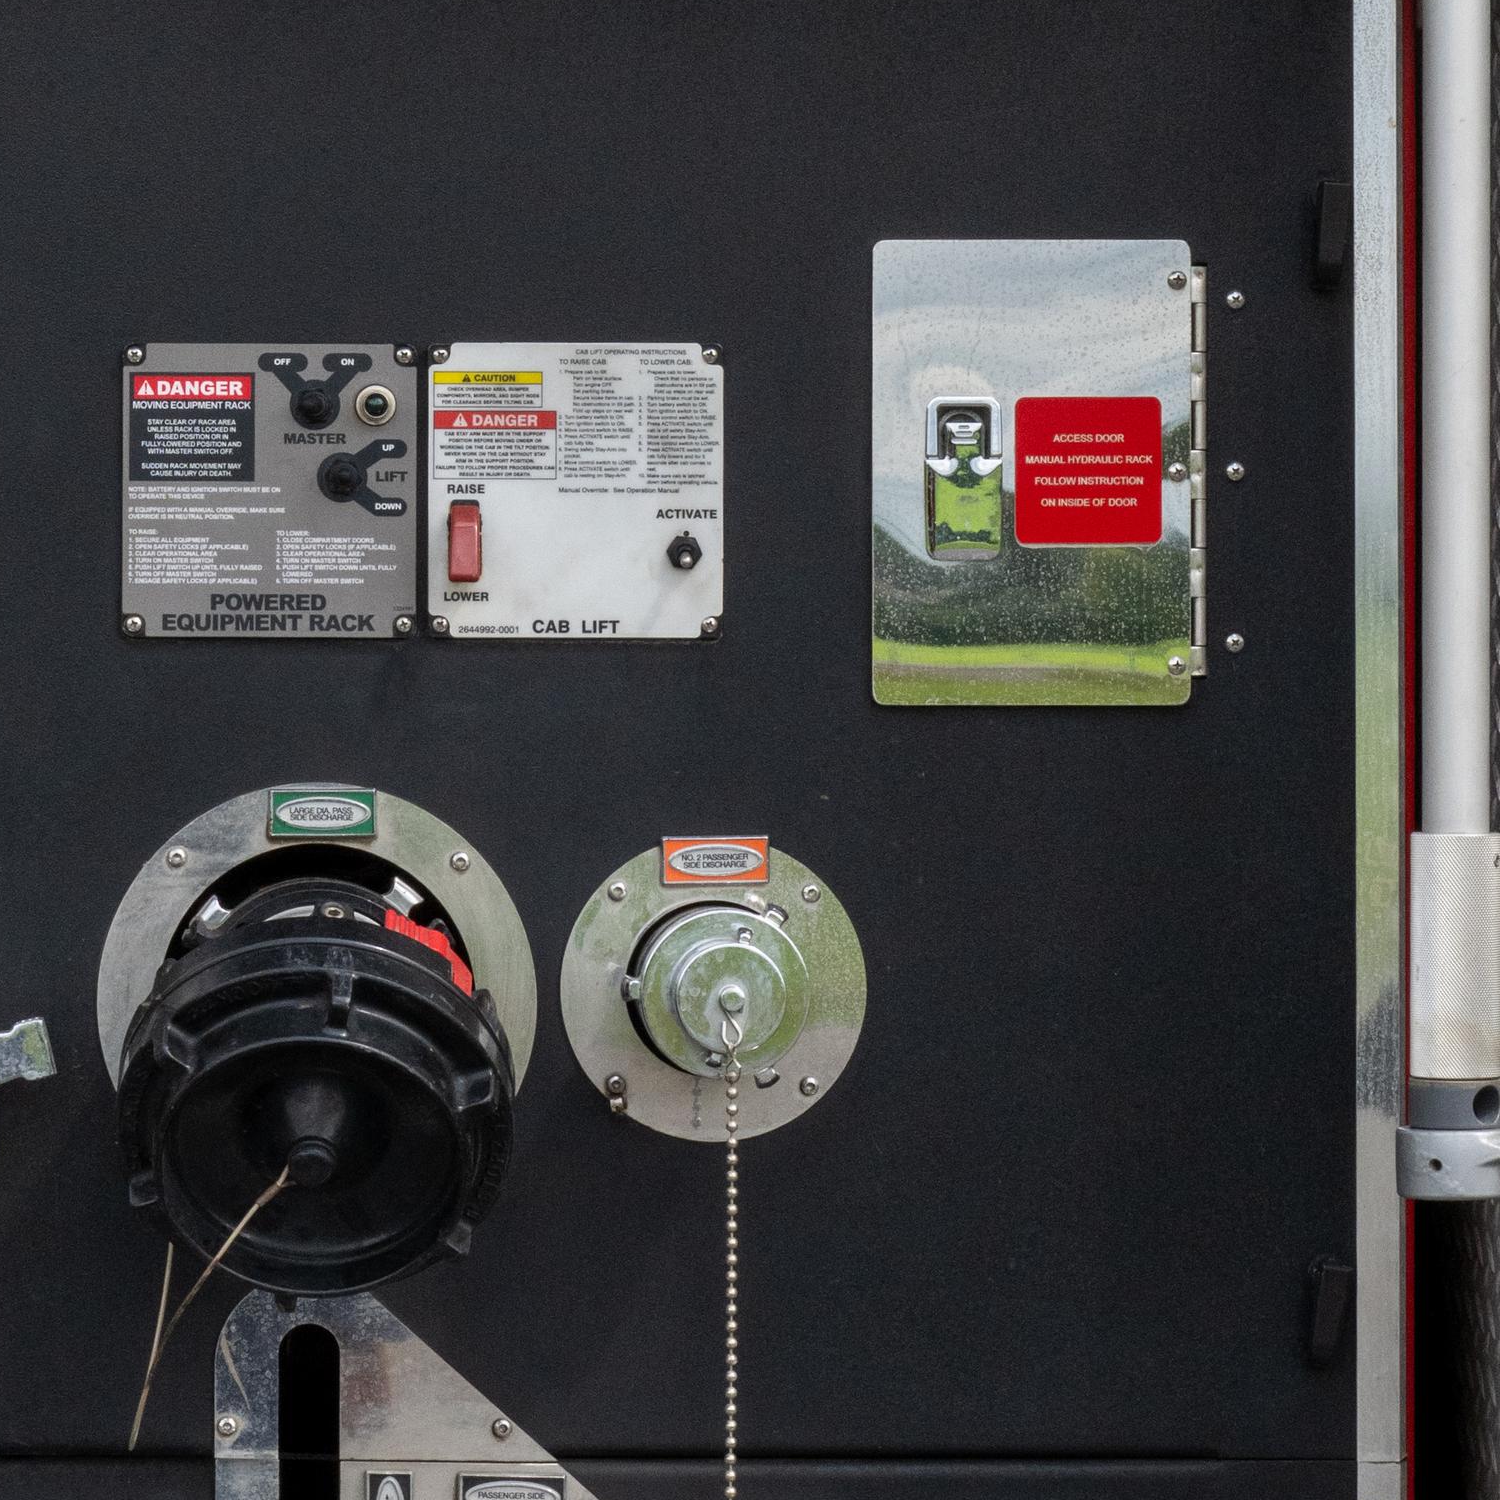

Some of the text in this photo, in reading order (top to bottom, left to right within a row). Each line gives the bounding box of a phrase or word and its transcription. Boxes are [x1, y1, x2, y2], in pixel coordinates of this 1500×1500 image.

[474, 374, 516, 382] CAUTION
[157, 380, 243, 396] DANGER
[132, 401, 251, 410] MOVING EQUIPMENT RACK
[472, 414, 538, 427] DANGER
[284, 433, 346, 444] MASTER
[1053, 434, 1125, 443] ACCESS DOOR
[1025, 455, 1153, 464] MANUAL HYDRAULIC RACK
[376, 471, 408, 482] LIFT
[1035, 476, 1144, 485] FOLLOW INSTRUCTION
[447, 484, 485, 494] RAISE
[1041, 498, 1138, 507] ON INSIDE OF DOOR
[656, 509, 717, 519] ACTIVATE
[211, 594, 326, 610] POWERED
[443, 592, 489, 602] LOWER
[162, 614, 375, 631] EQUIPMENT RACK
[532, 620, 620, 634] CAB LIFT
[458, 626, 519, 634] 2644992-0001
